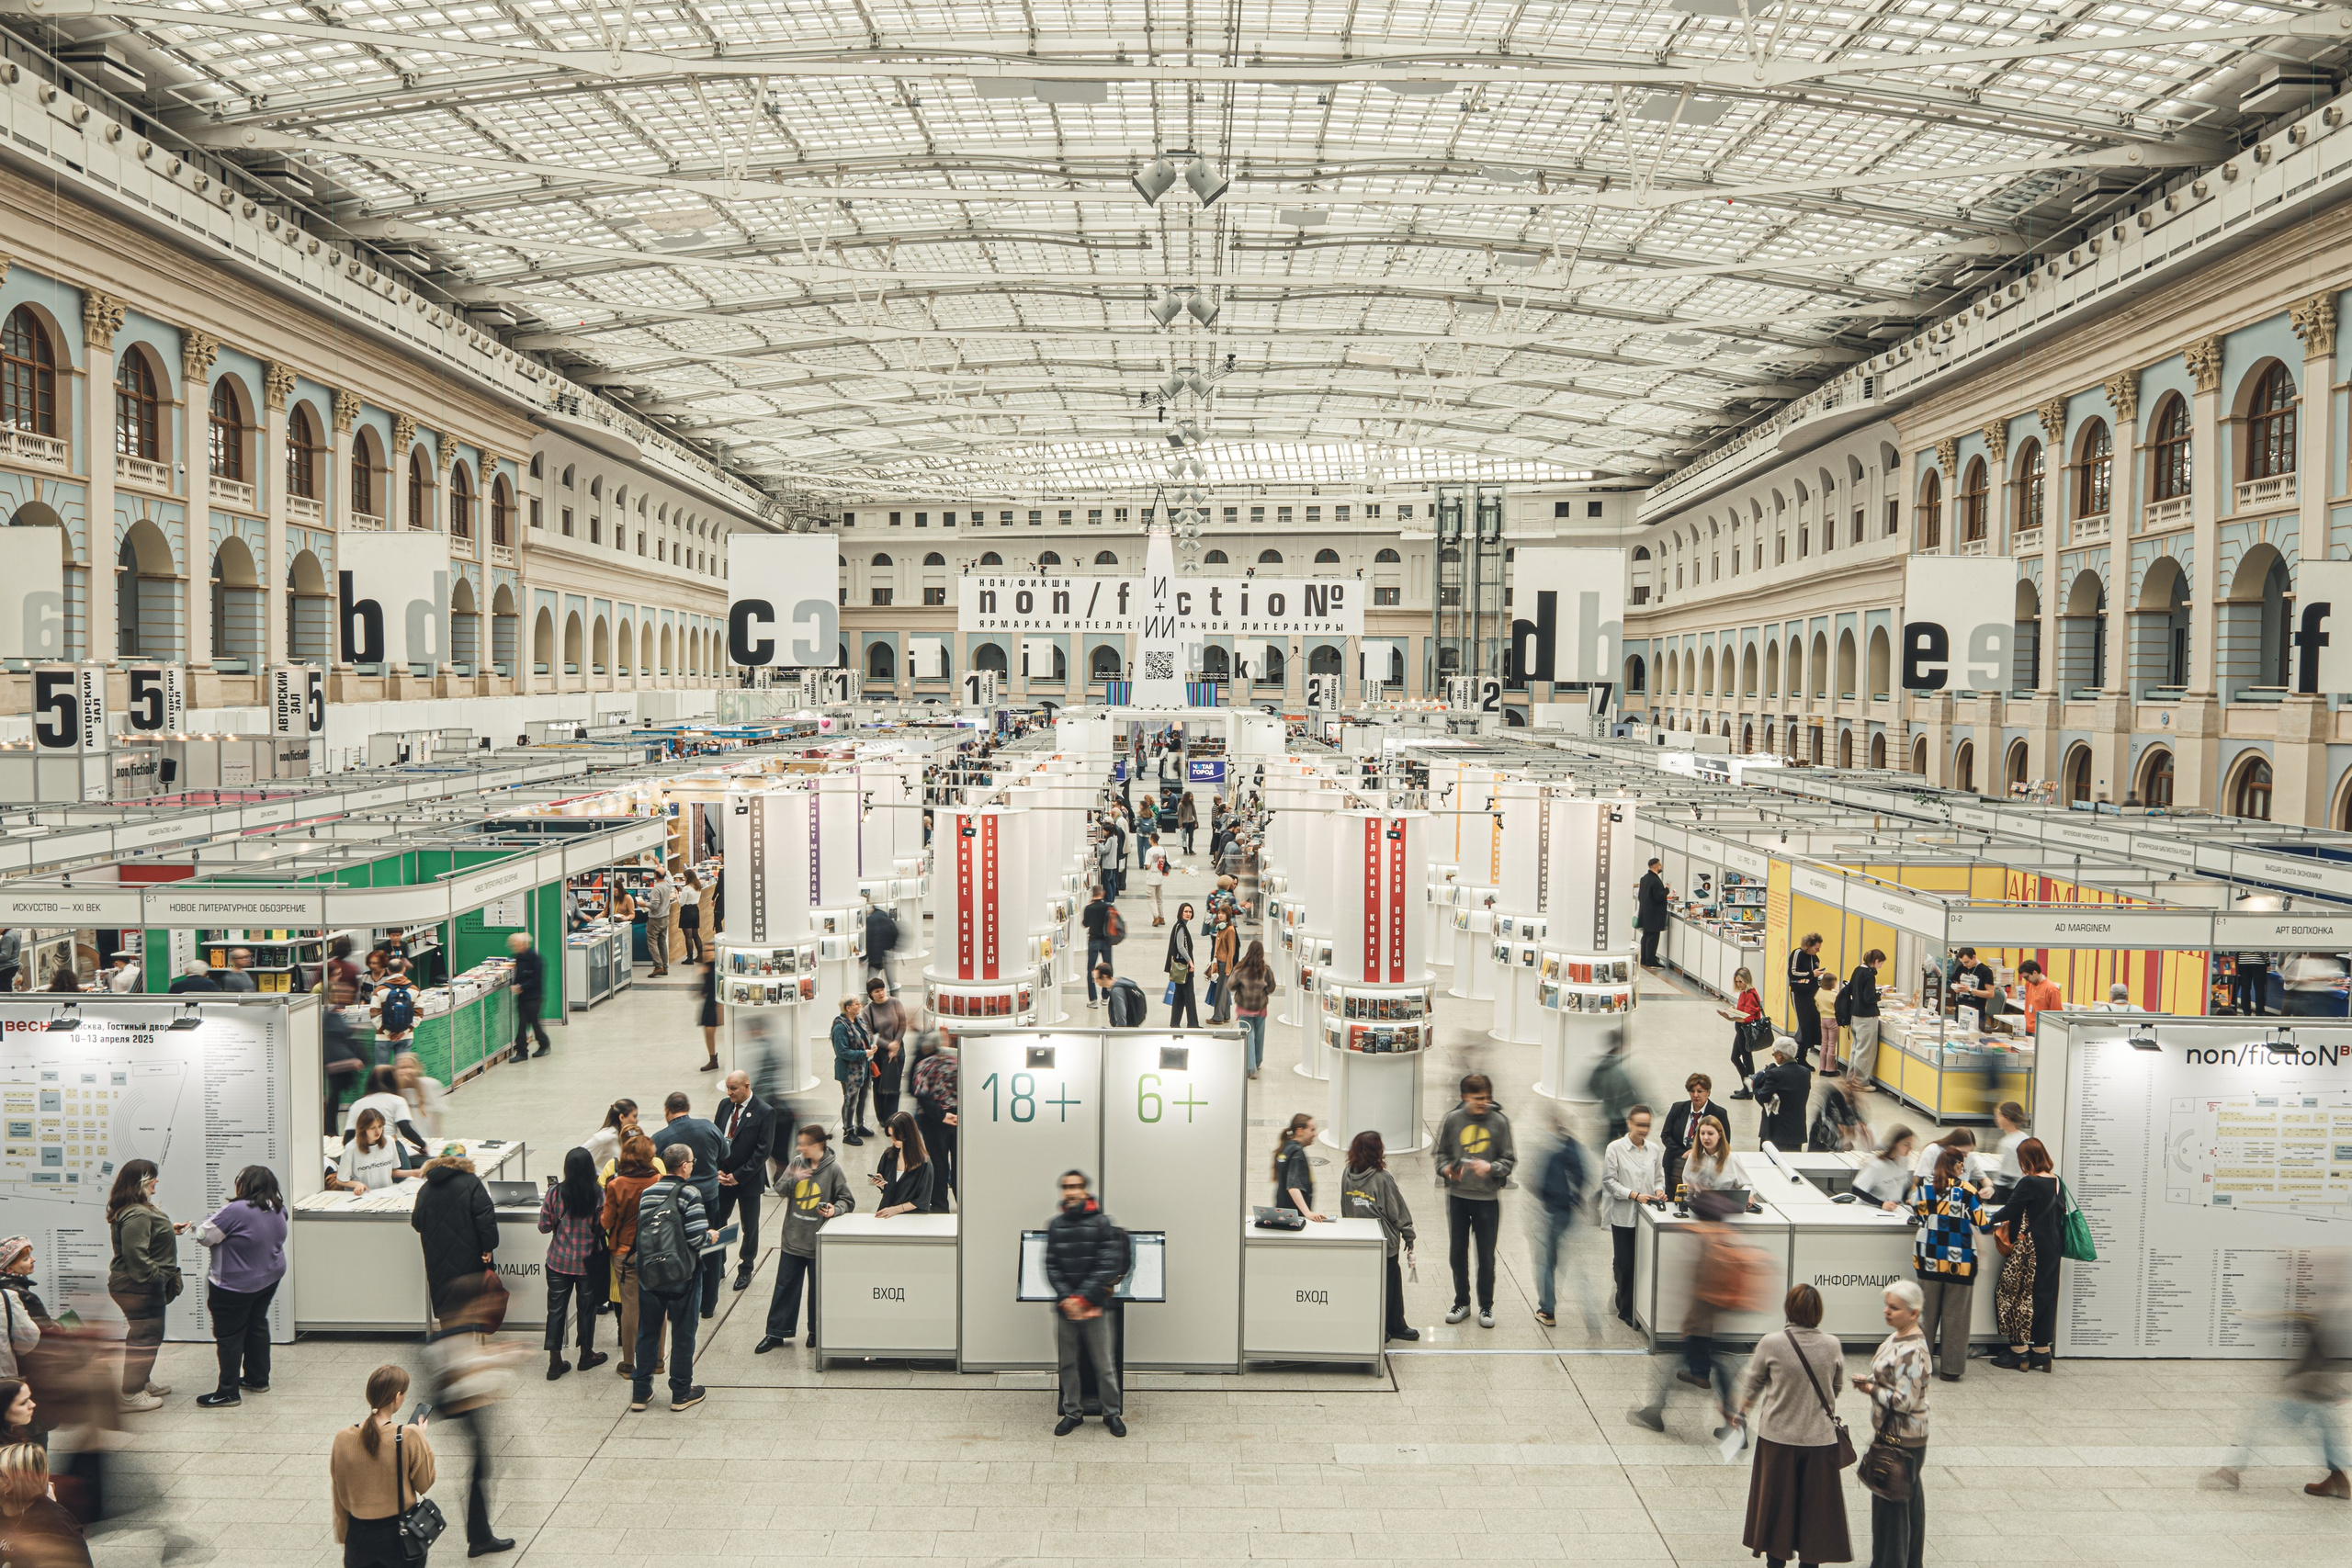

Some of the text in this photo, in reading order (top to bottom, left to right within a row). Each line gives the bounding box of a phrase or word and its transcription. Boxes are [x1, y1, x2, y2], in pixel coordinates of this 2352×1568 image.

[979, 579, 1070, 588] НОН/ФИКШН
[729, 599, 775, 665] c
[979, 620, 1051, 629] ЯРМАРКА
[1242, 622, 1344, 631] ЛИТЕРАТУРЫ
[130, 671, 164, 730] 5
[166, 671, 175, 729] АВТОРСКИЙ
[275, 671, 288, 731] АВТОРСКИЙ
[309, 672, 322, 731] 5
[834, 674, 848, 701] 1
[965, 676, 979, 705] 1
[1308, 679, 1319, 705] 2
[1483, 682, 1499, 712] 2
[36, 671, 78, 748] 5
[81, 671, 94, 747] АВТОРСКИЙ
[291, 694, 300, 714] ЗАЛ
[1597, 808, 1608, 949] ТОП-ЛИСТ ВЗРОСЛЫМ
[2265, 864, 2323, 880] ВЫСШАЯ ШКОЛА ЭКОНОМИКИ
[13, 903, 58, 912] ИСКУССТВО
[73, 903, 86, 912] XXI
[88, 903, 101, 912] ВЕК
[169, 903, 306, 913] НОВОЕ ЛИТЕРАТУРНОЕ ОБОЗРЕНИЕ
[755, 874, 763, 942] ВЗРОСЛЫМ
[987, 903, 995, 964] ПОБЕДЫ
[2055, 923, 2111, 932] AD MARGINEM
[2276, 926, 2334, 935] АРТ ВОЛХОНКА
[100, 1036, 130, 1044] апреля
[132, 1034, 154, 1043] 2025
[107, 1021, 147, 1031] Гостиный
[982, 1073, 1081, 1123] 18+
[1137, 1073, 1208, 1123] 6+
[873, 1287, 905, 1303] ВХОД
[1296, 1290, 1329, 1306] ВХОД
